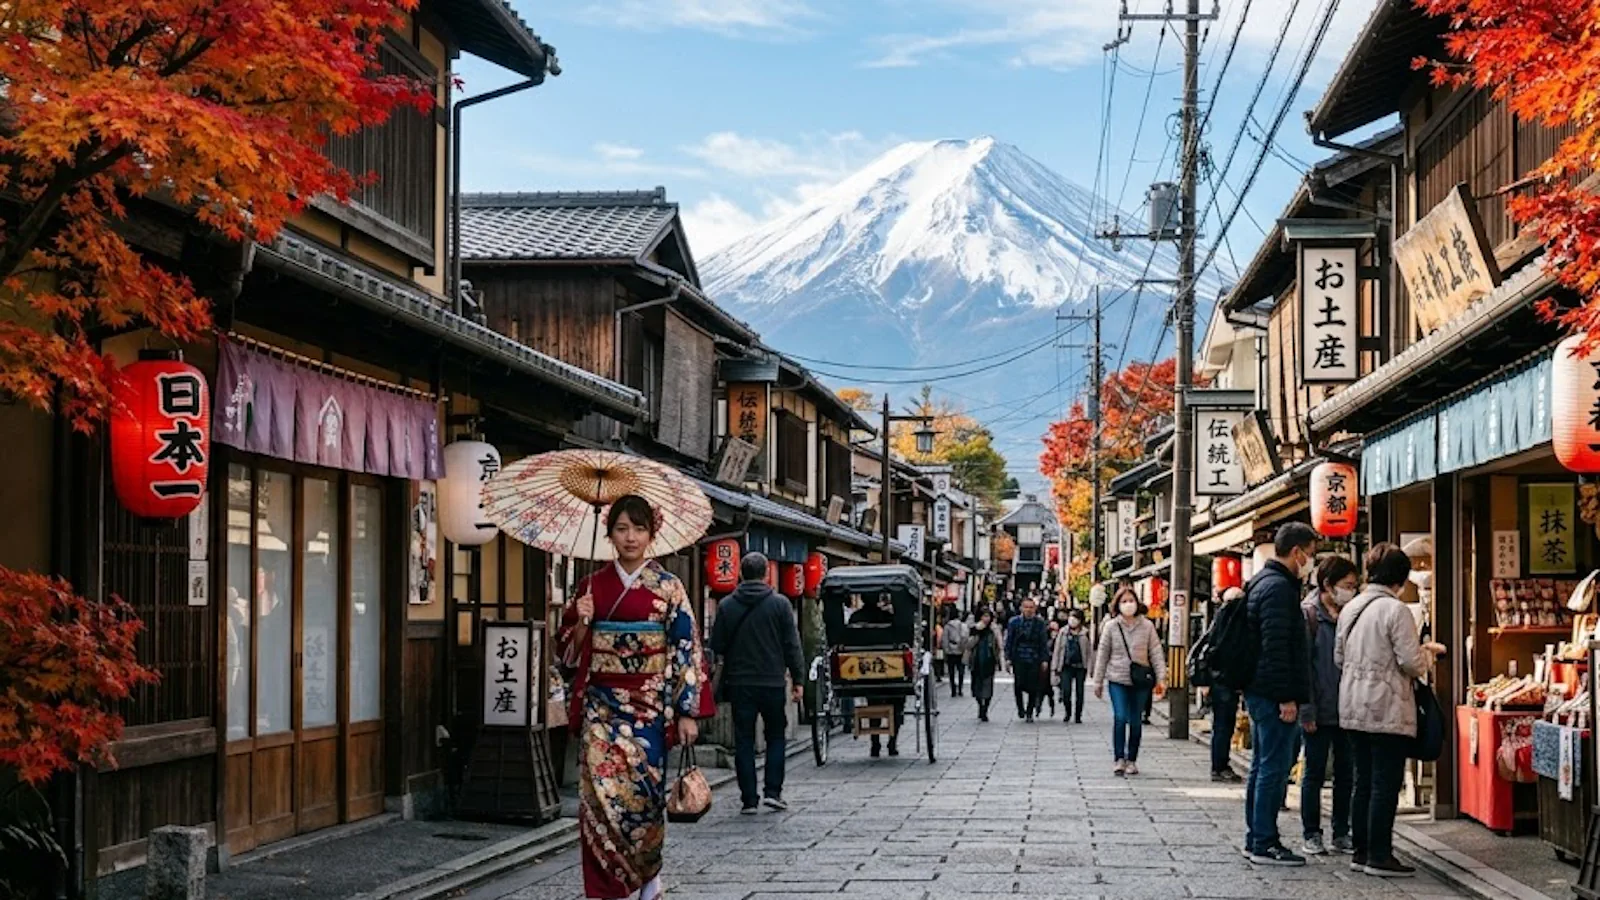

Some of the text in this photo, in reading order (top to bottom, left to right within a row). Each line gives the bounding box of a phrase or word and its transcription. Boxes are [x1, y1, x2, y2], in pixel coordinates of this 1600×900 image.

[1312, 257, 1347, 369] お土産
[150, 373, 205, 498] 日本一
[1207, 418, 1230, 487] 伝統工
[474, 452, 499, 530] 京一
[1540, 509, 1567, 565] 抹茶
[492, 635, 518, 714] お土産
